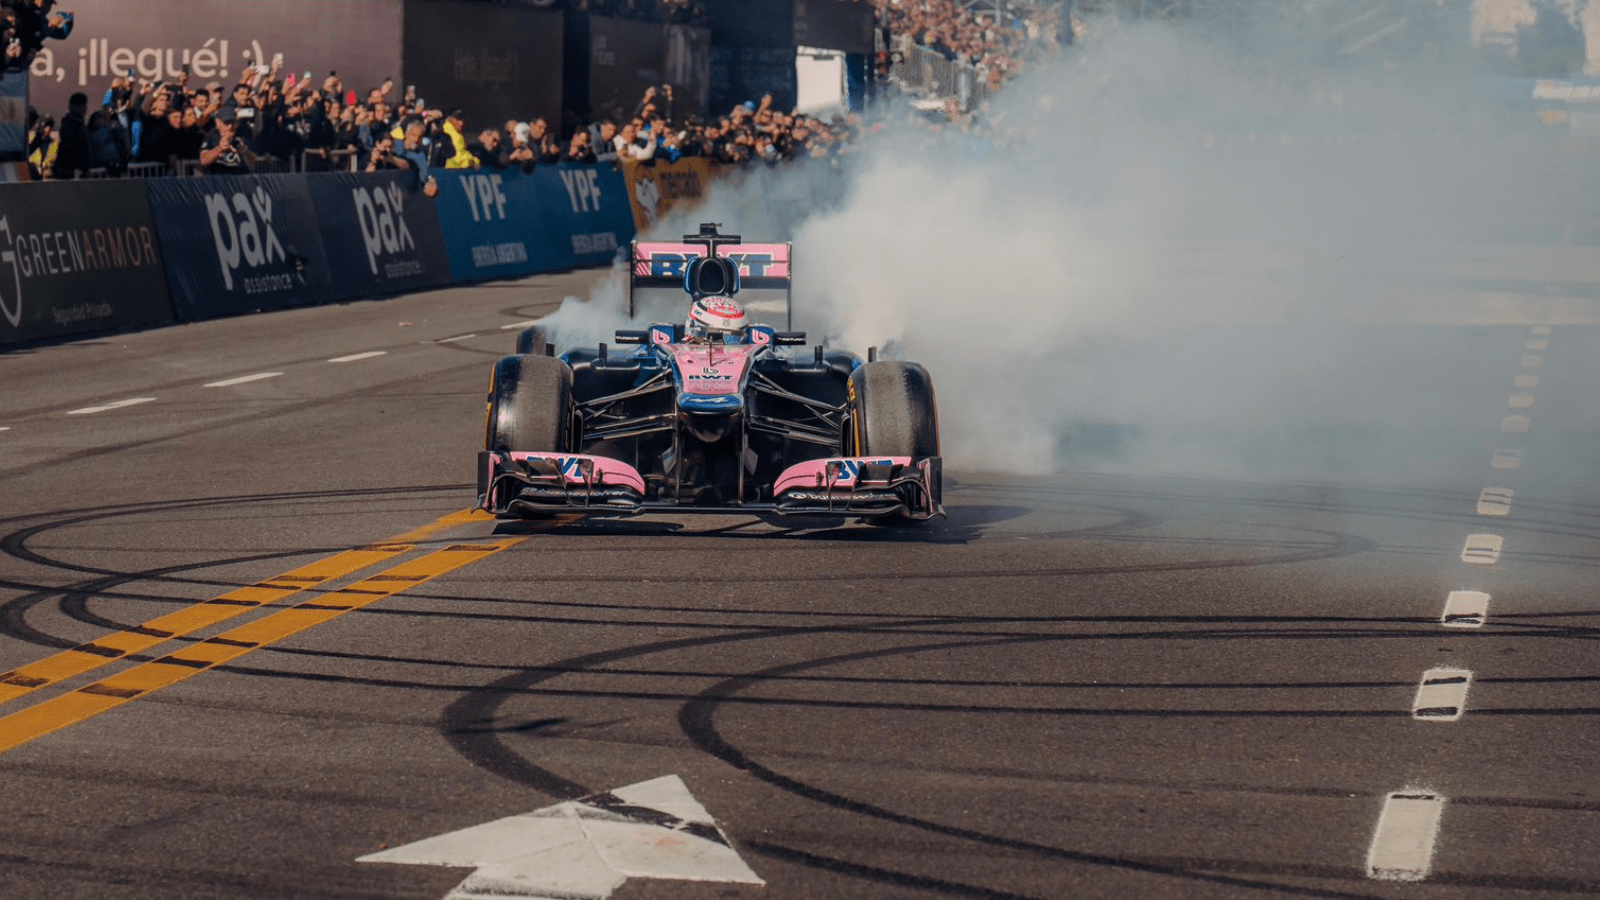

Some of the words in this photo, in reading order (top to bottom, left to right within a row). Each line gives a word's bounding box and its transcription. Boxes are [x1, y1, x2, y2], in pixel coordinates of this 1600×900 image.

[78, 37, 228, 86] ¡llegué!
[459, 174, 506, 221] YPF
[559, 169, 601, 212] YPF
[16, 226, 156, 277] GREENARMOR
[204, 186, 286, 291] pax
[352, 181, 415, 275] pax
[244, 274, 293, 294] assistance
